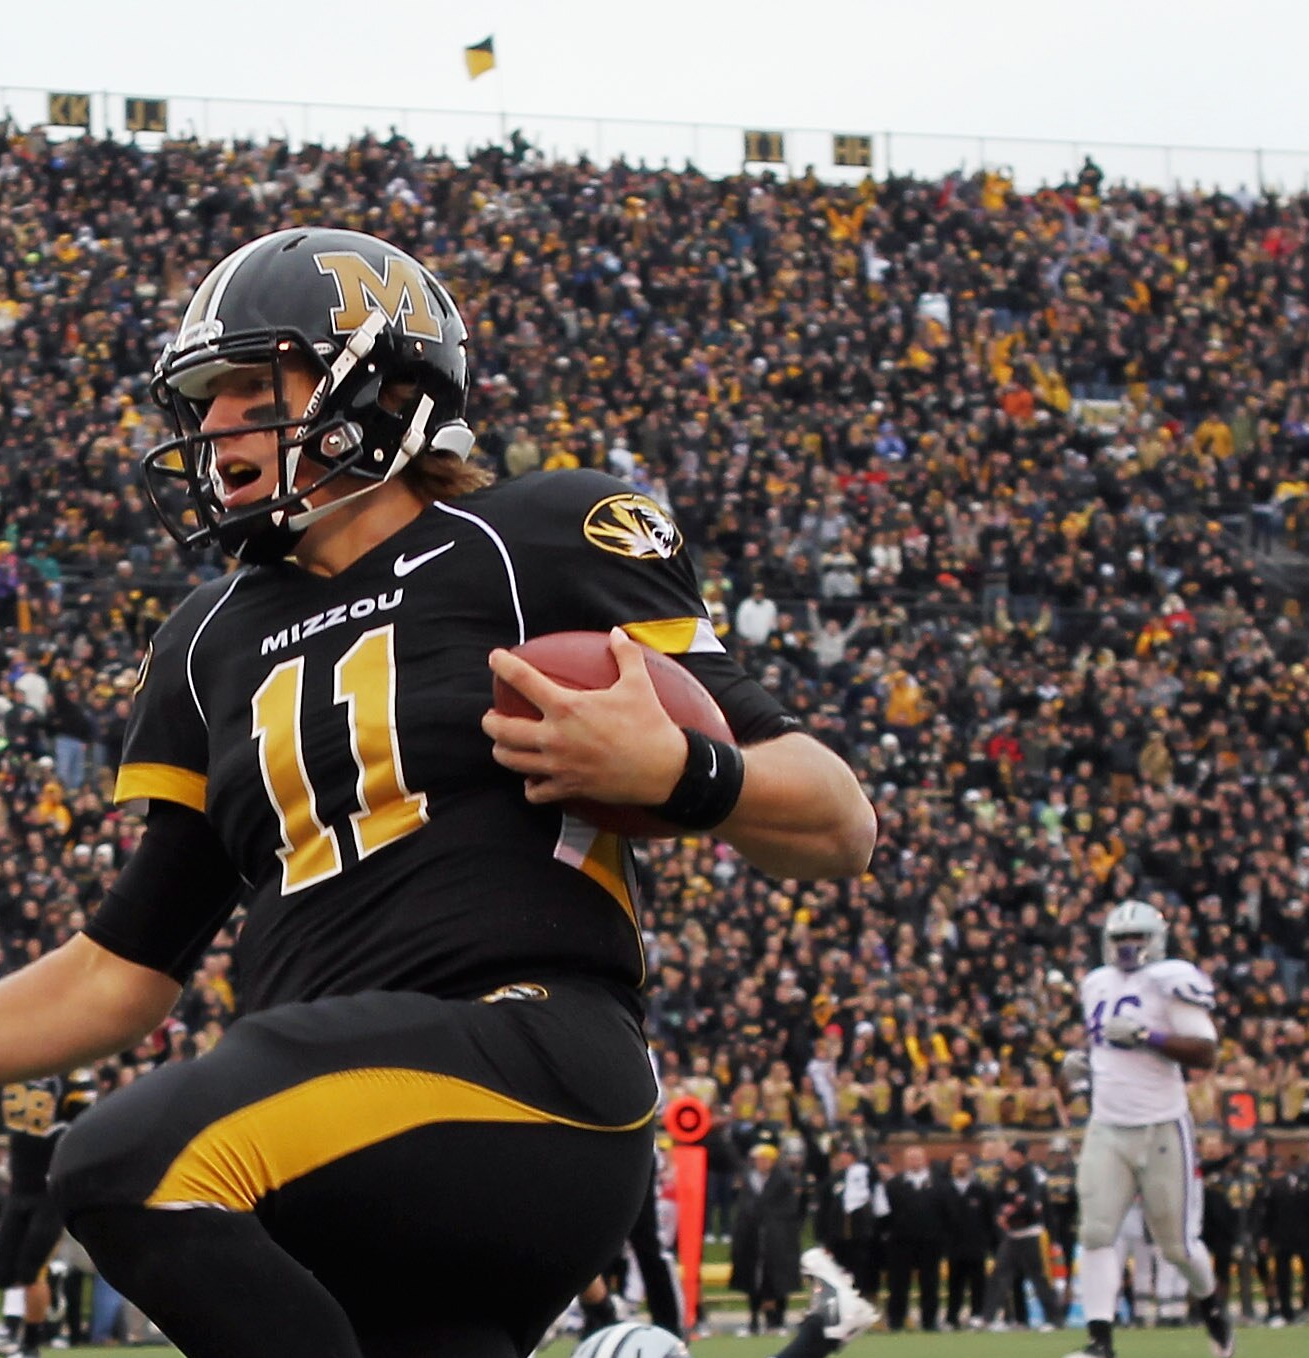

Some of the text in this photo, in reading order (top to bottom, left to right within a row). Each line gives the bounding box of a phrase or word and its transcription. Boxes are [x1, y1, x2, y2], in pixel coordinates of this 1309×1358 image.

[312, 250, 444, 343] M
[261, 588, 404, 656] MIZZOU
[251, 623, 431, 897] 11
[1227, 1092, 1258, 1131] 3
